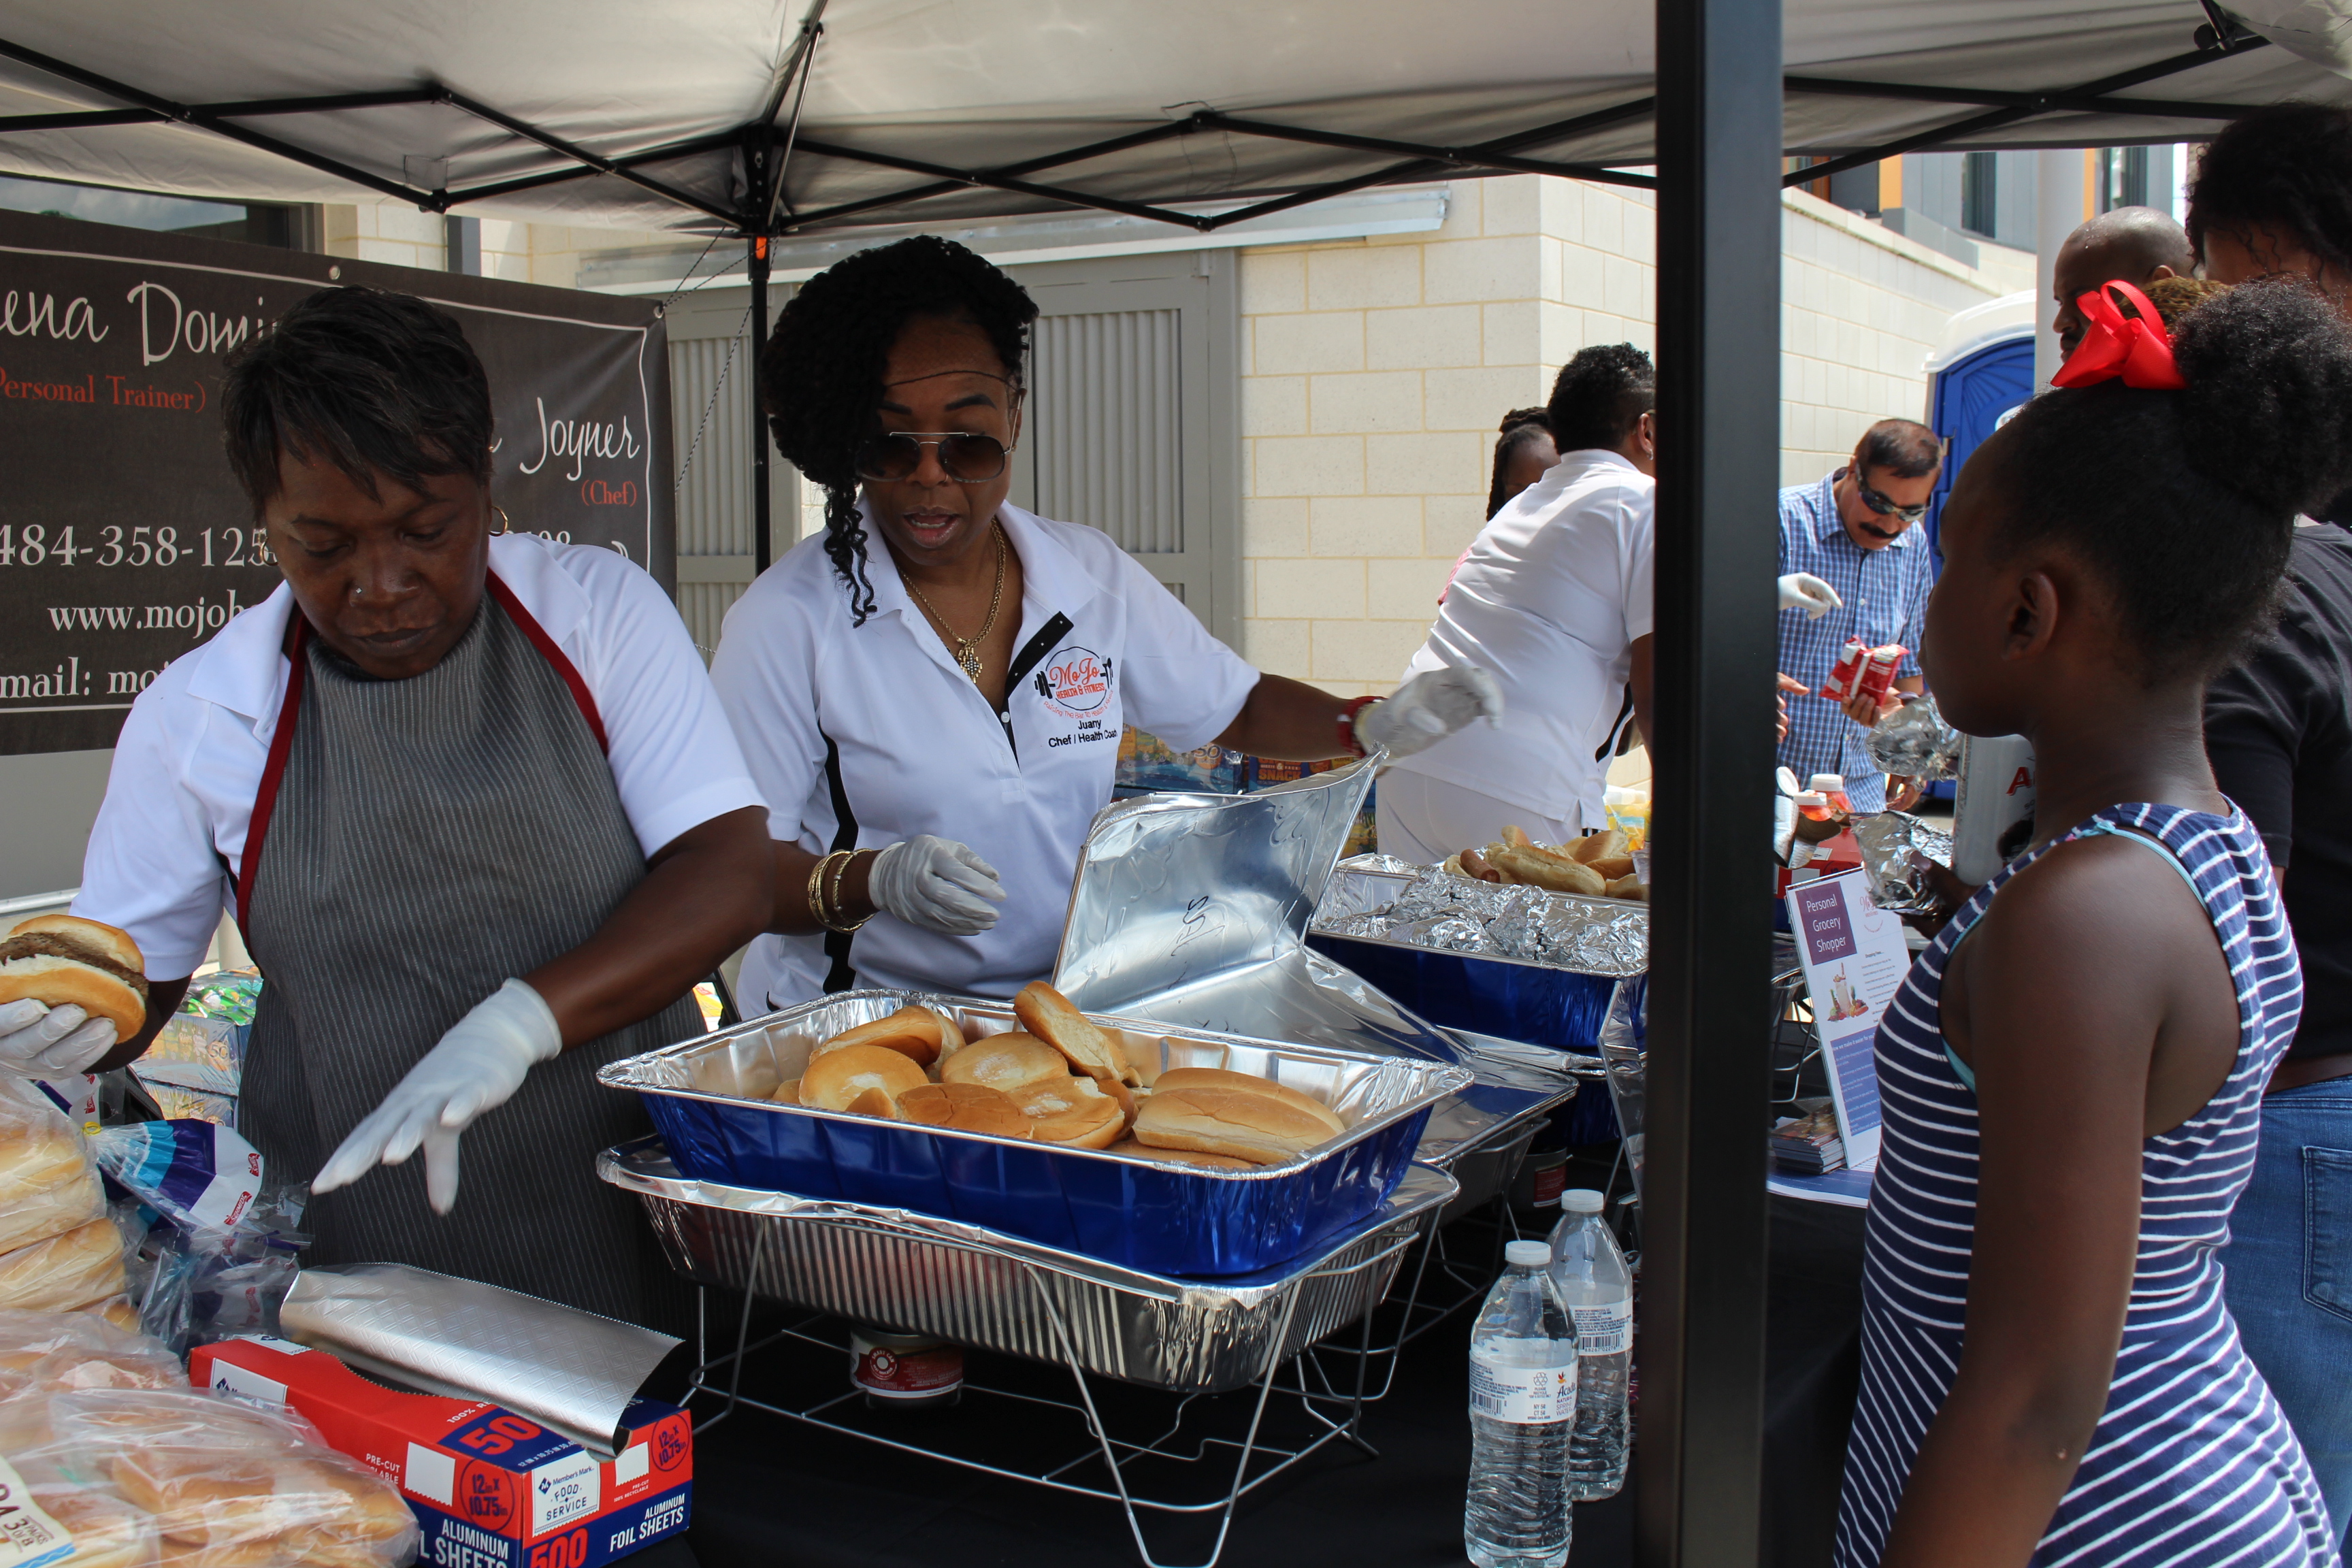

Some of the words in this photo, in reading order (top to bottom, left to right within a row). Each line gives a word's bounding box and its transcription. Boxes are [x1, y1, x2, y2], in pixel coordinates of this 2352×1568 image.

[127, 281, 278, 366] Domi
[105, 375, 206, 414] Trainer)
[519, 397, 640, 481] Joyner
[581, 480, 638, 507] (Chef)
[0, 524, 278, 568] 484-358-125
[47, 589, 259, 638] www.mojoh
[107, 661, 169, 694] mo
[1049, 657, 1100, 689] MoJo
[1056, 687, 1078, 699] HEALTH
[1077, 685, 1083, 696] &
[1083, 683, 1106, 694] FITNESS
[1043, 701, 1062, 717] Raising
[1064, 710, 1074, 719] The
[1078, 719, 1102, 730] Juany
[1048, 734, 1072, 747] Chef
[1073, 734, 1076, 744] /
[1079, 731, 1103, 743] Health
[1104, 729, 1117, 739] Coach
[1258, 769, 1302, 781] SNACK
[1276, 762, 1284, 770] &
[1806, 894, 1838, 913] Personal
[1812, 917, 1841, 932] Grocery
[1816, 936, 1846, 953] Shopper
[872, 1350, 885, 1360] SMART
[886, 1353, 895, 1363] CAN
[447, 1408, 476, 1423] 100%
[659, 1439, 686, 1466] 10.75in
[366, 1453, 400, 1473] PRE-CUT
[553, 1469, 578, 1486] Member's
[579, 1465, 593, 1476] Mark
[632, 1479, 649, 1490] PRE-CUT
[555, 1484, 579, 1501] FOOD
[624, 1485, 649, 1499] RECYCLABLE
[470, 1496, 508, 1517] 10.75in
[546, 1496, 587, 1521] SERVICE
[644, 1492, 685, 1520] ALUMINUM
[442, 1518, 509, 1560] ALUMINUM
[610, 1527, 636, 1552] FOIL
[639, 1506, 684, 1539] SHEETS
